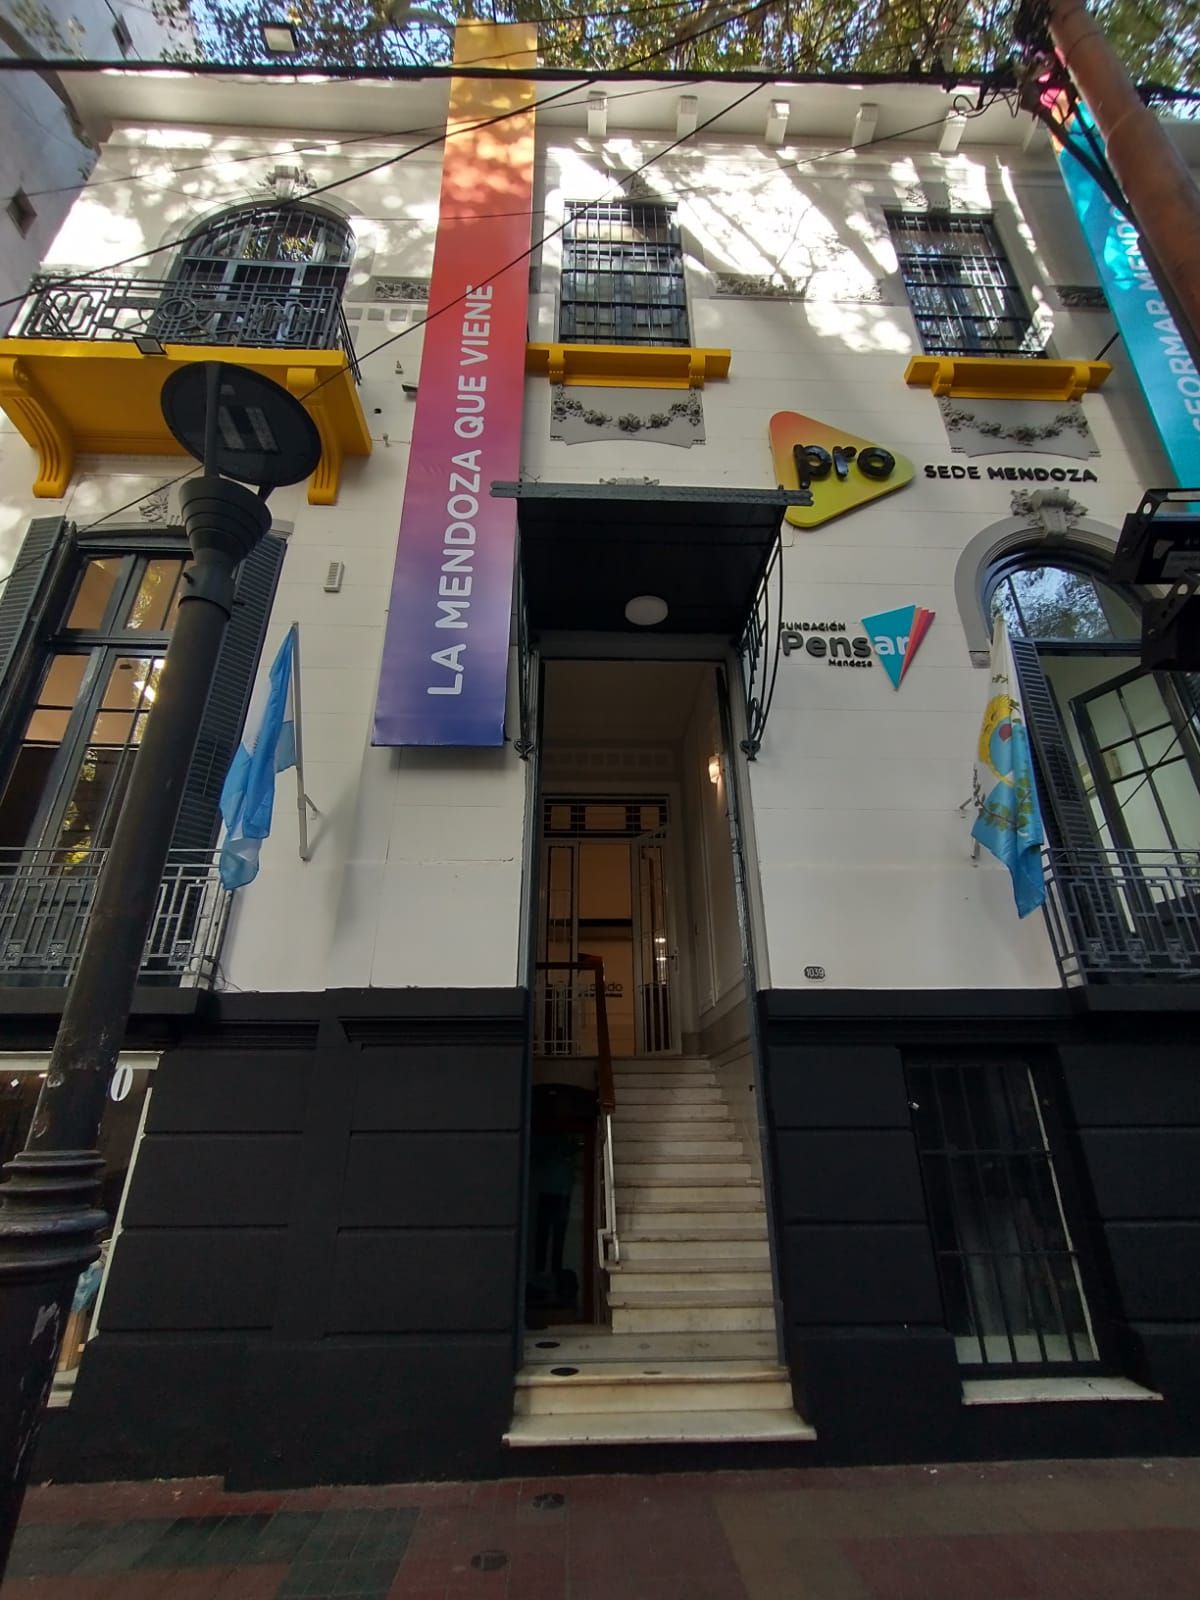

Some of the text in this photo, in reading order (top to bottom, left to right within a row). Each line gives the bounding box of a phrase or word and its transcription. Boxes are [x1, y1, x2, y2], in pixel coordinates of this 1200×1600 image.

[793, 444, 896, 489] pro
[924, 465, 1098, 483] SEDE MENDOZA
[427, 284, 493, 695] LA MENDOZA QUE VIENE
[781, 630, 910, 658] Pensar
